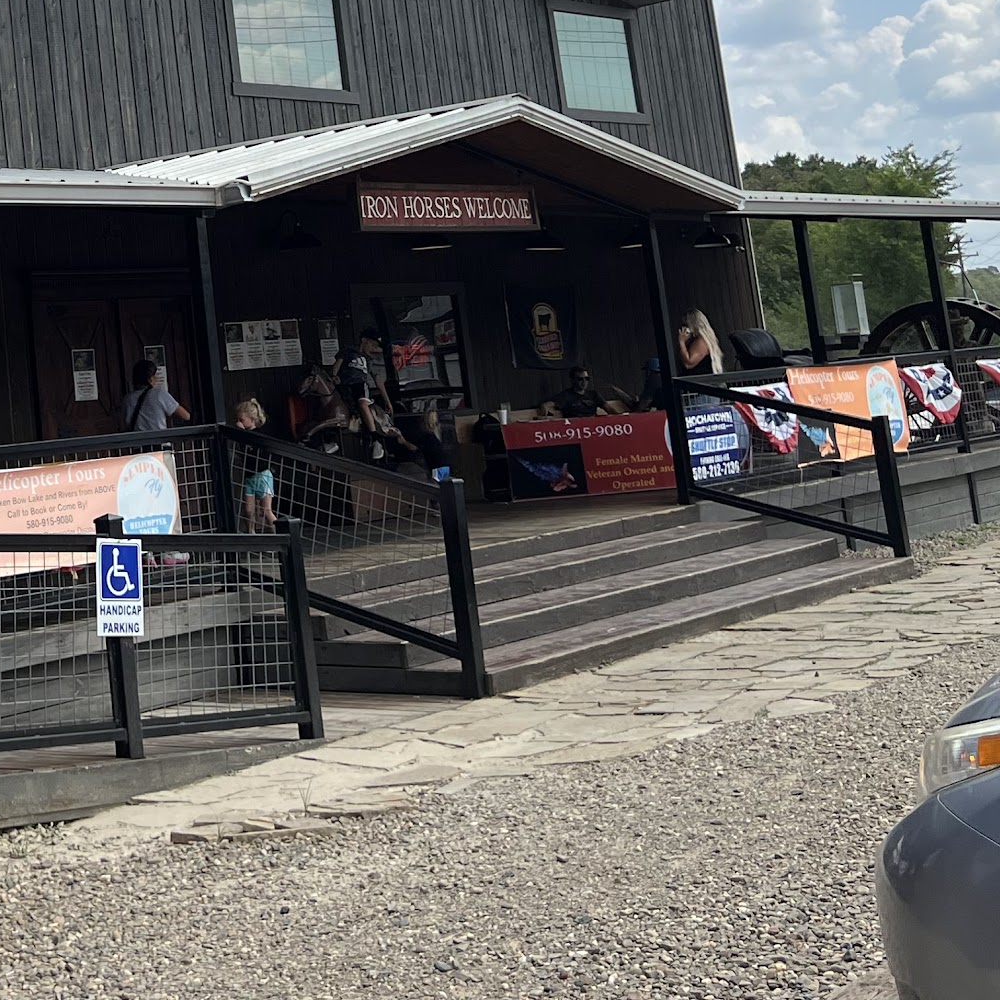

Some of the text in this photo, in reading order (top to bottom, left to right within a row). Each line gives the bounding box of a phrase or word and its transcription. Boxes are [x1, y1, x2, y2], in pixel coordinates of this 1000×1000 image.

[360, 195, 532, 219] IRON HORSES WELCOME
[685, 411, 734, 429] HOCHATOWN
[719, 436, 736, 450] STOP
[595, 453, 664, 467] Female Marine
[65, 464, 105, 483] Tours
[586, 469, 622, 480] Veteran
[623, 465, 658, 476] Owned
[612, 478, 656, 491] Operated
[12, 496, 27, 505] Bow
[28, 494, 44, 503] Lake
[45, 492, 57, 500] and
[58, 490, 78, 499] Rivers
[79, 488, 94, 496] from
[94, 484, 117, 494] ABOVE
[7, 509, 21, 519] Call
[22, 508, 29, 517] to
[30, 506, 48, 516] Book
[57, 503, 76, 512] Come
[26, 514, 74, 529] 580-915-9080
[99, 604, 142, 616] HANDICAP
[102, 622, 140, 634] PARKING
